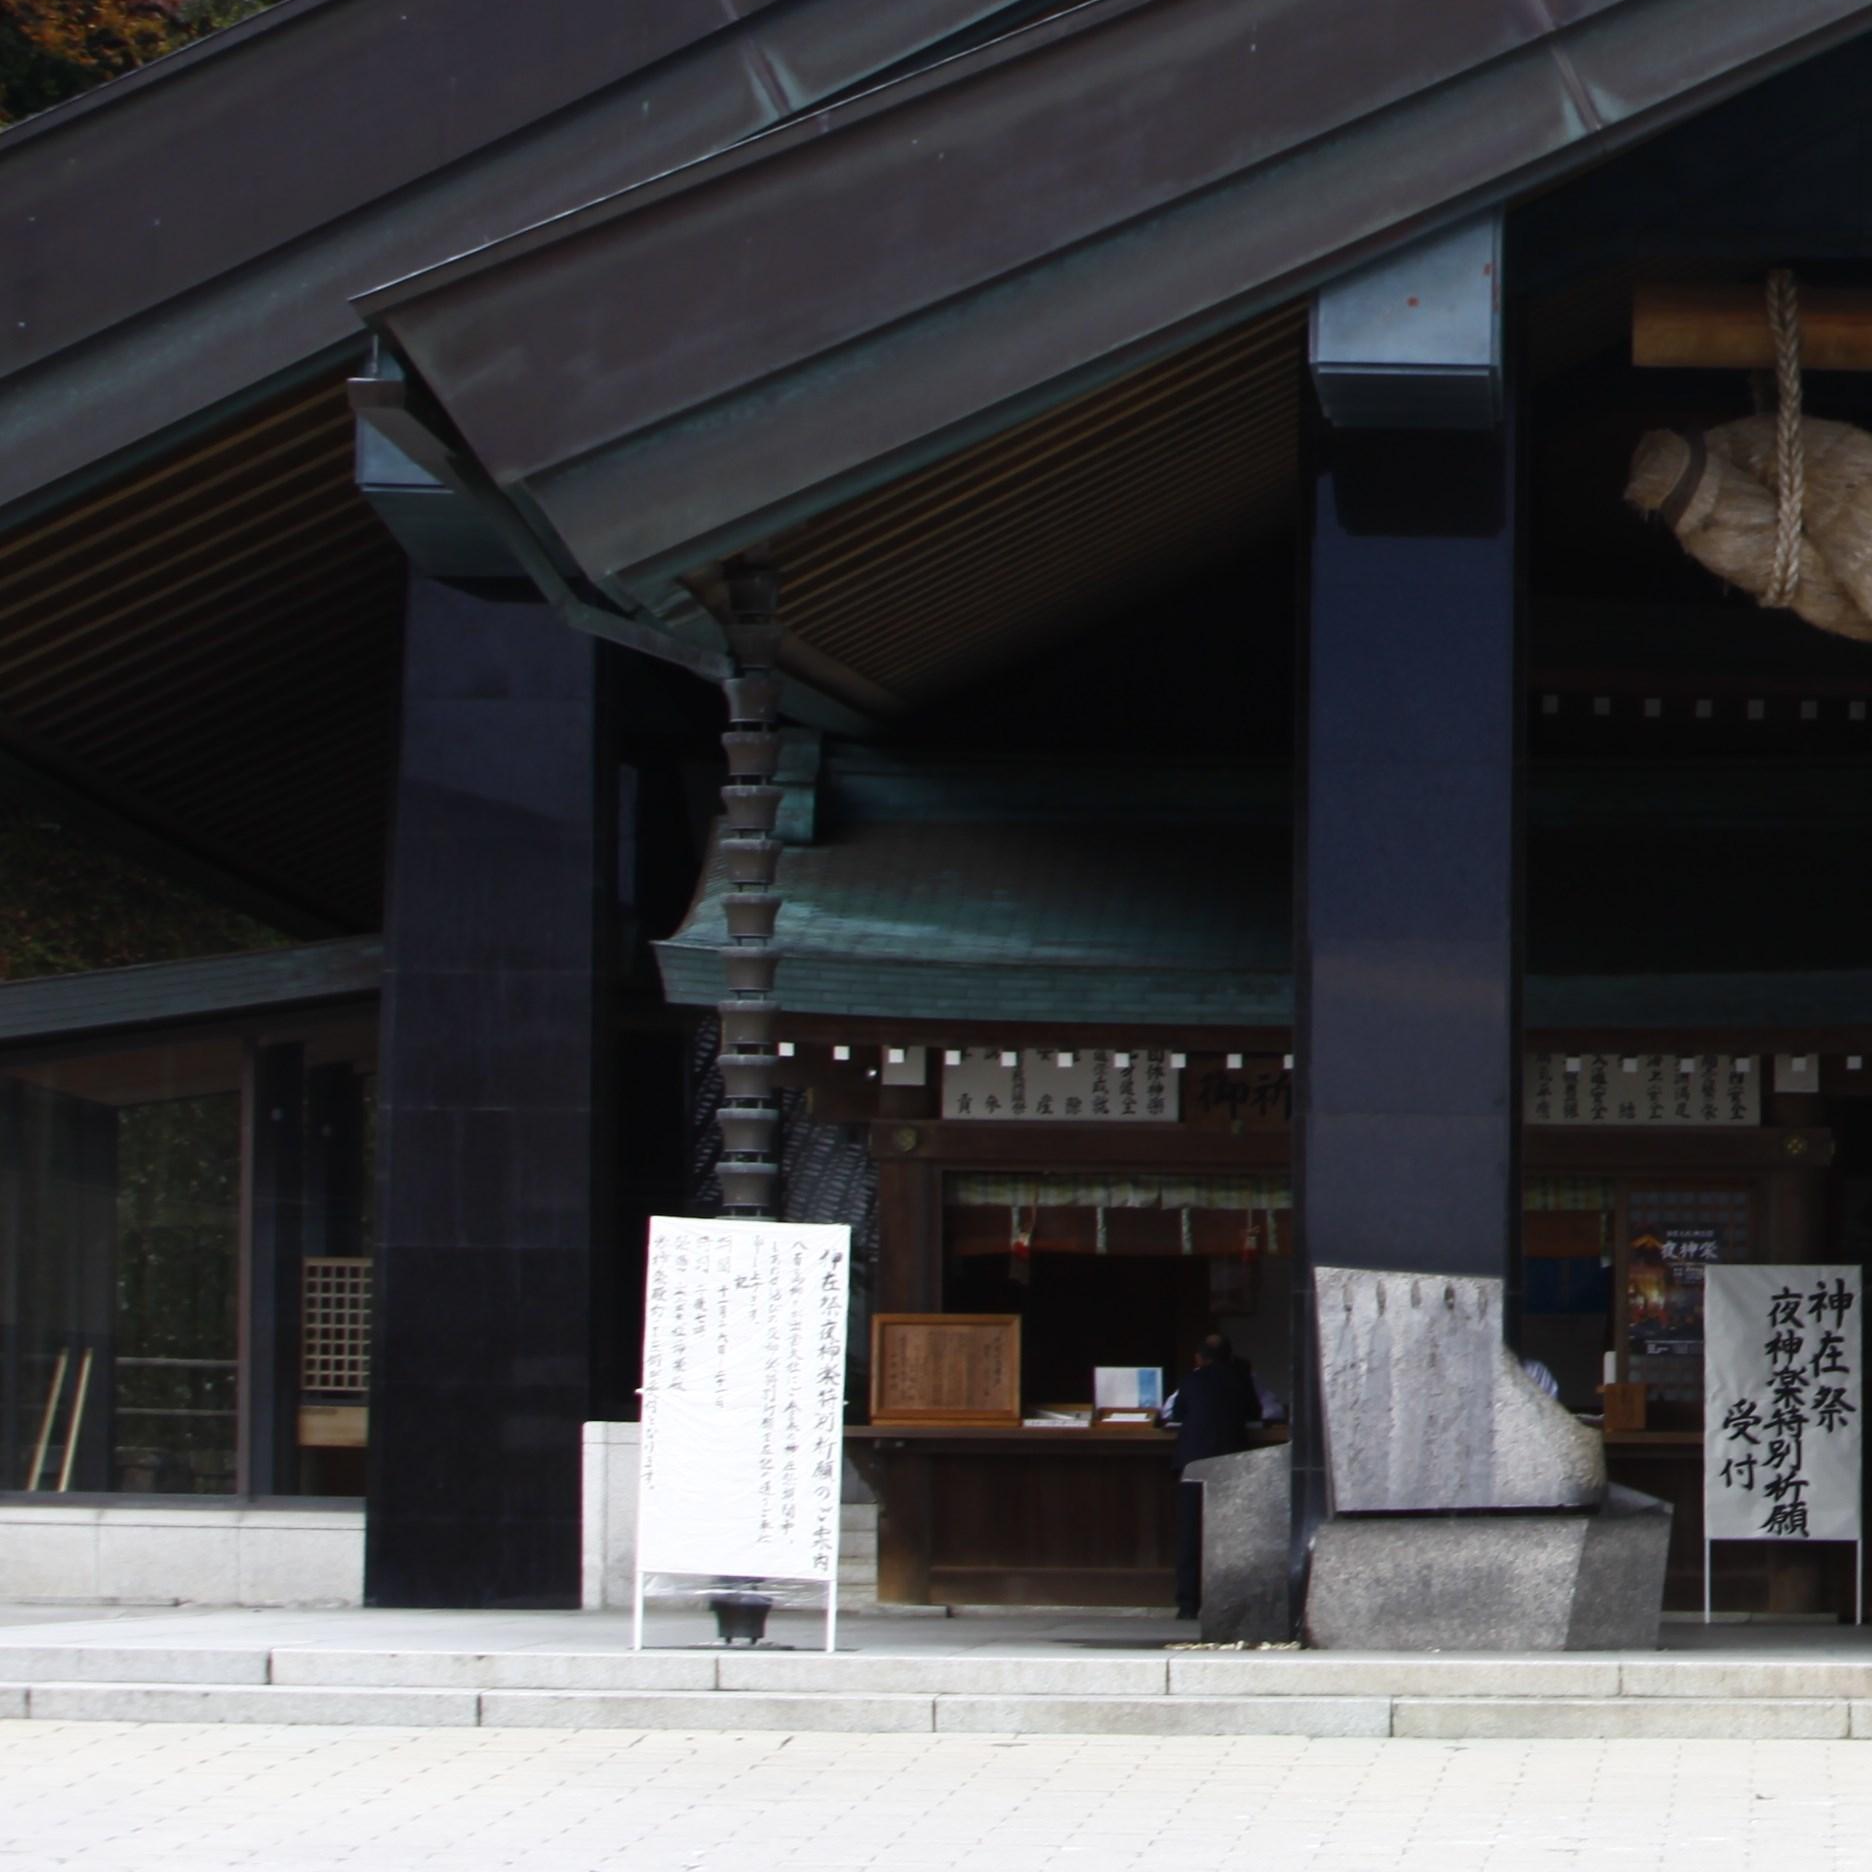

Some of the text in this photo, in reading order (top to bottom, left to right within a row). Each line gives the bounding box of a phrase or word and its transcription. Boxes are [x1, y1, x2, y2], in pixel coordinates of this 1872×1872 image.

[1759, 1285, 1811, 1538] 夜神楽特別祈願
[1808, 1277, 1856, 1433] 神在祭
[1719, 1397, 1763, 1492] 受付
